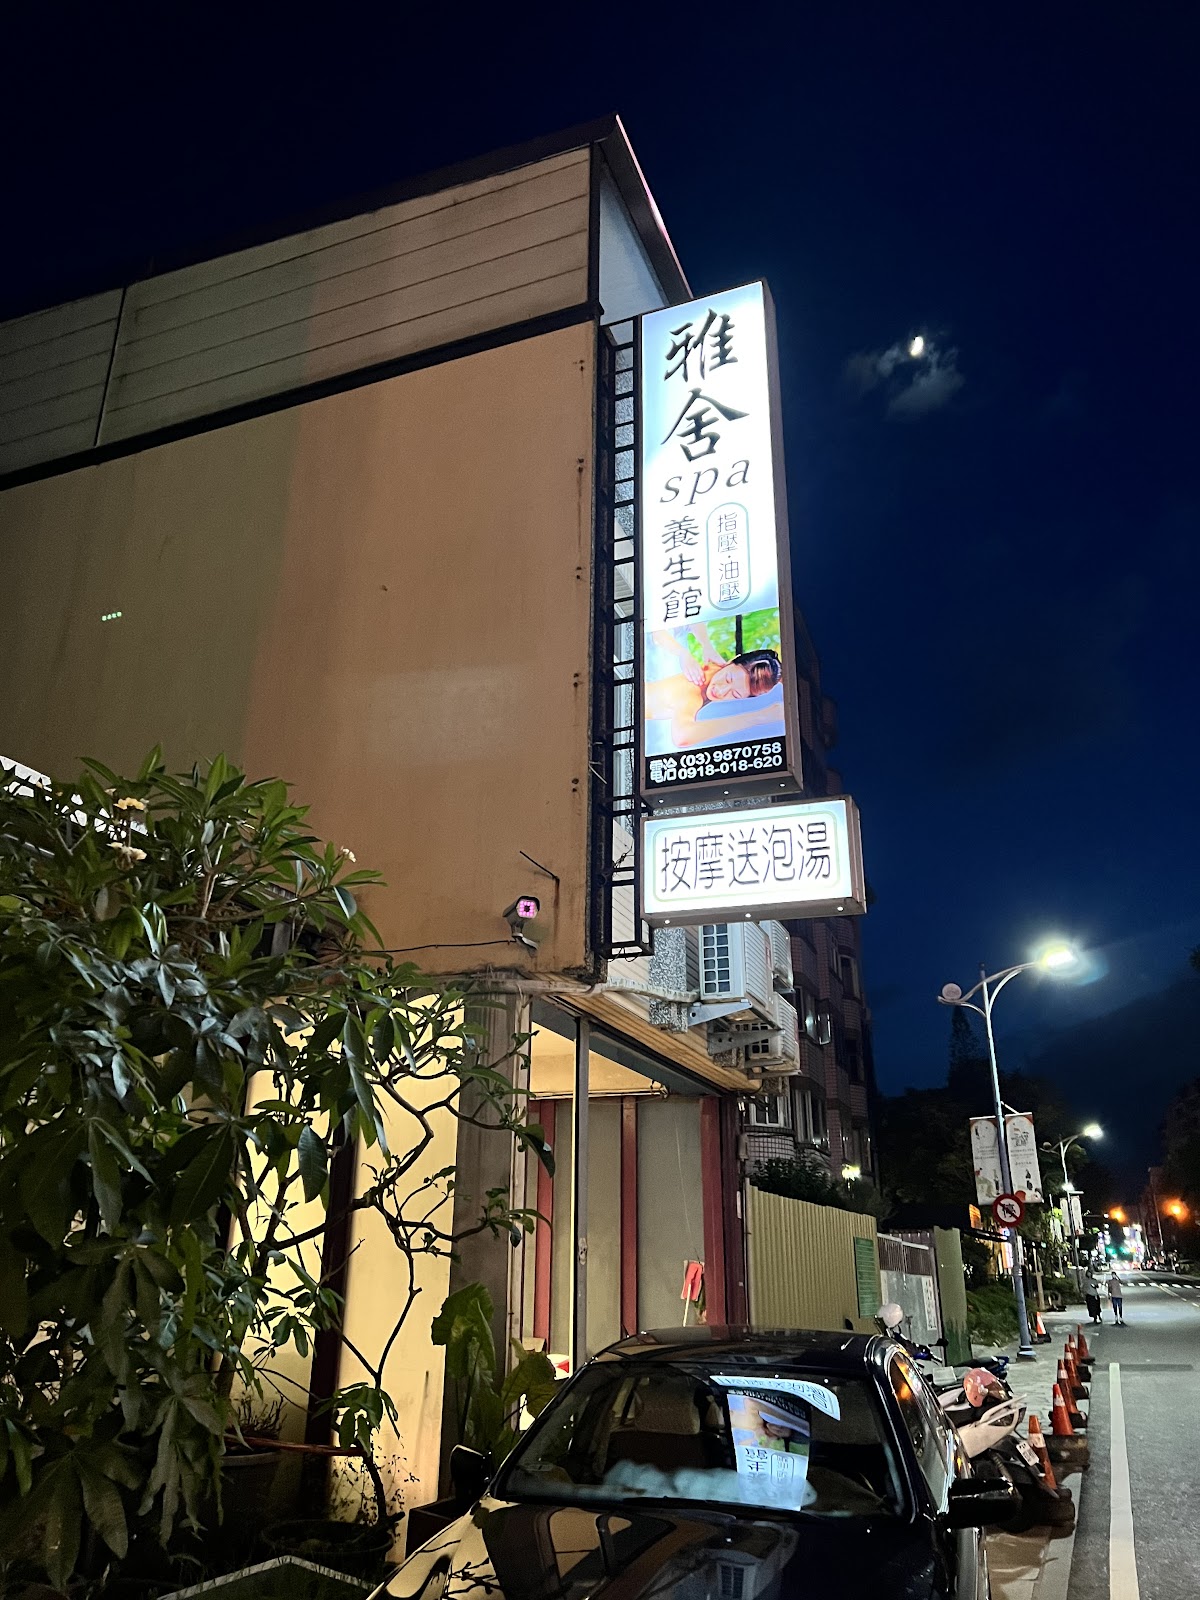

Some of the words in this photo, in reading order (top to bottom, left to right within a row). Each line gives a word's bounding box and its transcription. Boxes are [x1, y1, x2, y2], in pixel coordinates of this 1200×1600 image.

[661, 308, 750, 462] 雅舍
[660, 458, 750, 507] spa
[661, 515, 703, 622] 養生館
[678, 755, 783, 780] 0918-018-620
[661, 821, 831, 893] 按摩送泡湯
